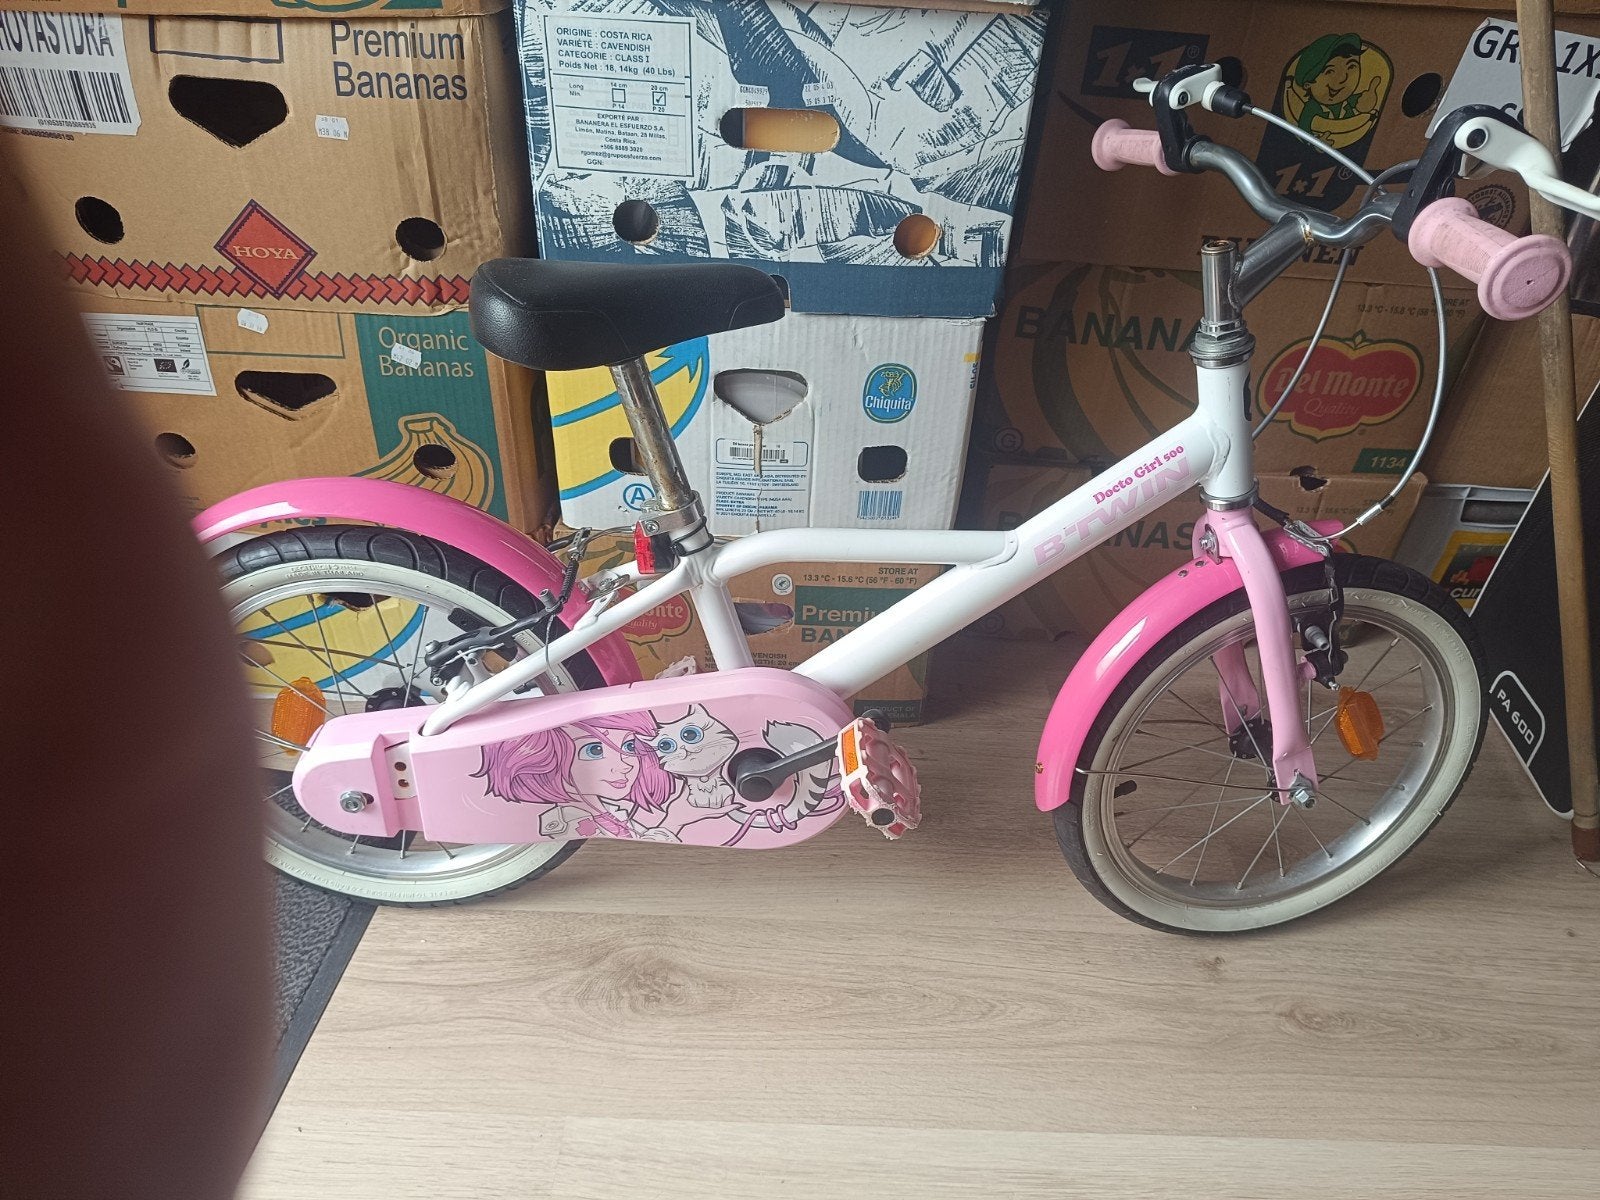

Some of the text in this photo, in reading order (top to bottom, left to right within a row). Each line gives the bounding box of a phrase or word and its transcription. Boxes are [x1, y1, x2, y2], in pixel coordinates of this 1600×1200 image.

[330, 20, 465, 60] Premium
[556, 27, 653, 41] ORIGINE COSTA RICA
[557, 38, 651, 52] VARIÉTÉ CAVENDISH
[1473, 25, 1600, 79] GR 1X
[558, 49, 607, 60] CATEGORIE
[615, 53, 644, 63] CLASS
[558, 60, 676, 77] Poids Net 18, 14kg (40 Lbs)
[333, 61, 468, 100] Bananas
[569, 83, 584, 91] Long
[597, 112, 626, 121] EXPORTÉ
[576, 119, 610, 127] BANANERA
[620, 123, 653, 131] ESFUERZO
[232, 245, 301, 260] HOYA
[378, 326, 469, 351] Organic
[1273, 368, 1410, 398] Del Monte
[864, 395, 913, 412] Chiquita
[1303, 398, 1361, 417] Quality
[1370, 456, 1407, 469] 1134
[1092, 444, 1185, 504] Docto Girl 500
[630, 487, 646, 504] A
[803, 574, 819, 582] 13.3
[878, 567, 906, 575] STORE
[802, 605, 876, 622] Premi
[628, 619, 658, 629] uality
[801, 628, 852, 643] BAN
[751, 652, 787, 660] VENDISH
[1497, 688, 1535, 745] PA 600
